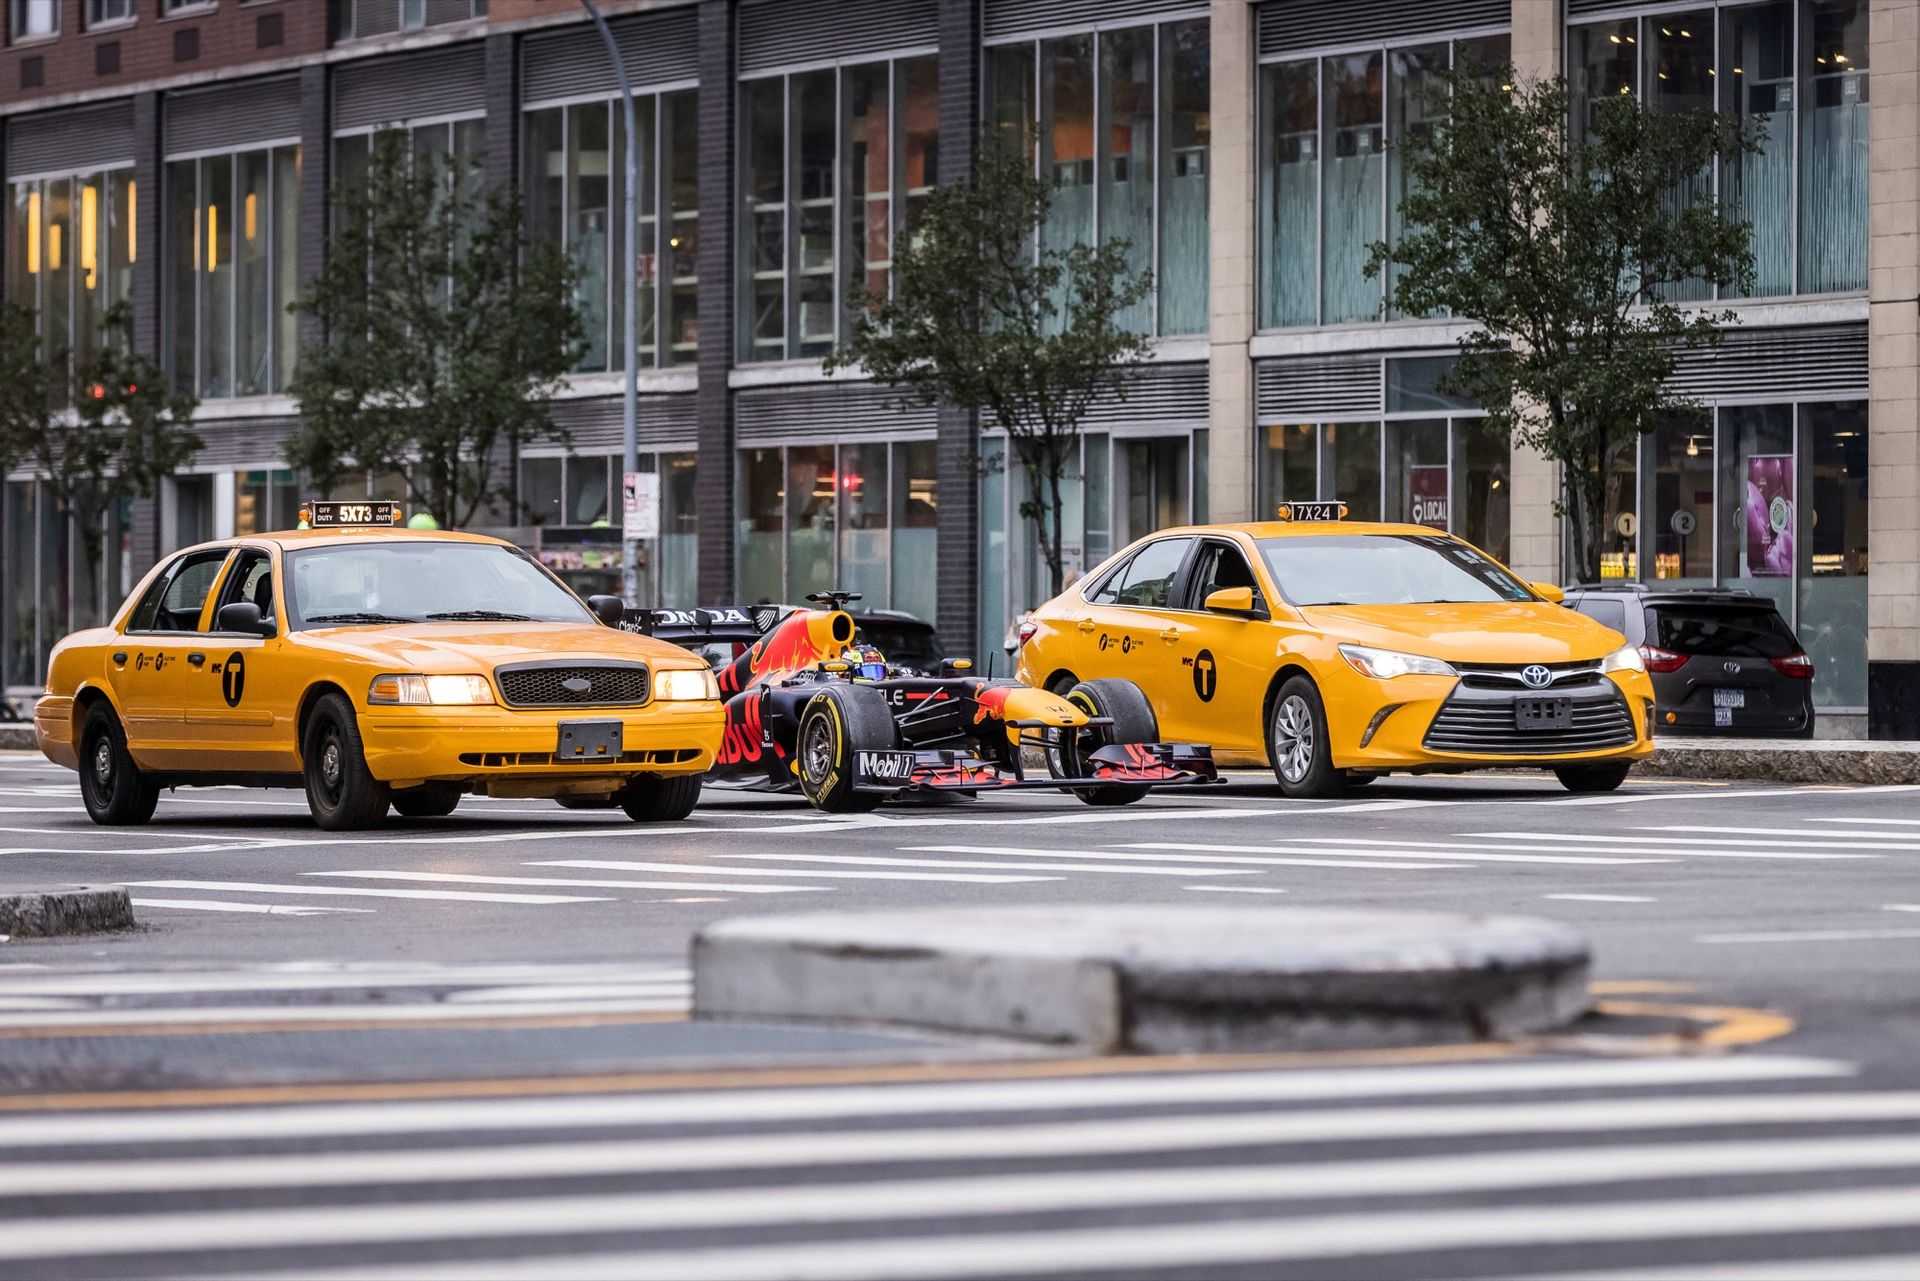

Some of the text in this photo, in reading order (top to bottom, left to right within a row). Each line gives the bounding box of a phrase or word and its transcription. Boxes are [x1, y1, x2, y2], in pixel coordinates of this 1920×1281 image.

[339, 505, 372, 522] 5X73
[1297, 505, 1331, 520] 7X24
[1423, 501, 1447, 520] LOCAL
[1623, 517, 1631, 532] 1
[1681, 516, 1689, 529] 2
[859, 752, 901, 778] Mobil
